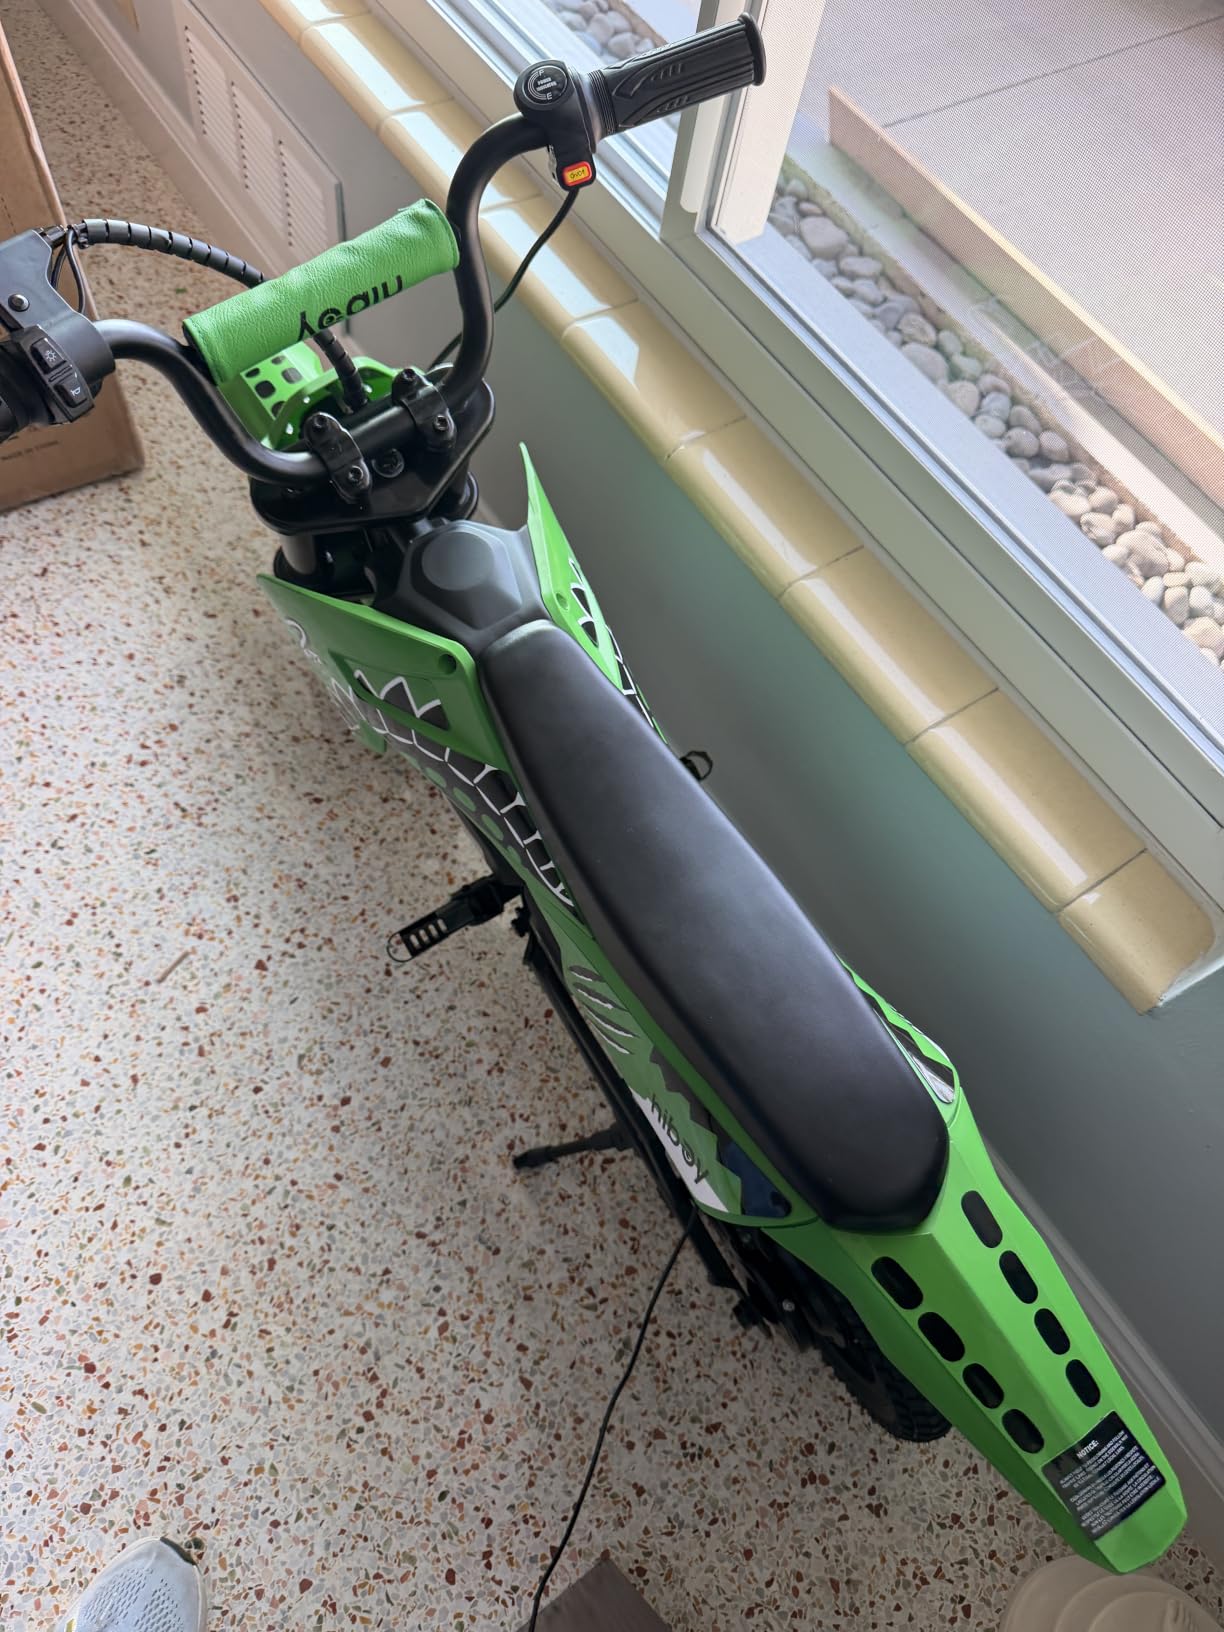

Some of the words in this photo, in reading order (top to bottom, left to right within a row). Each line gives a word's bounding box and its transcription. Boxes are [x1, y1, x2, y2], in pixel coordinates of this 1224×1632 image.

[538, 68, 544, 76] F
[546, 91, 553, 100] E
[651, 1093, 709, 1184] hiboy
[1076, 1440, 1100, 1459] NOTICE:
